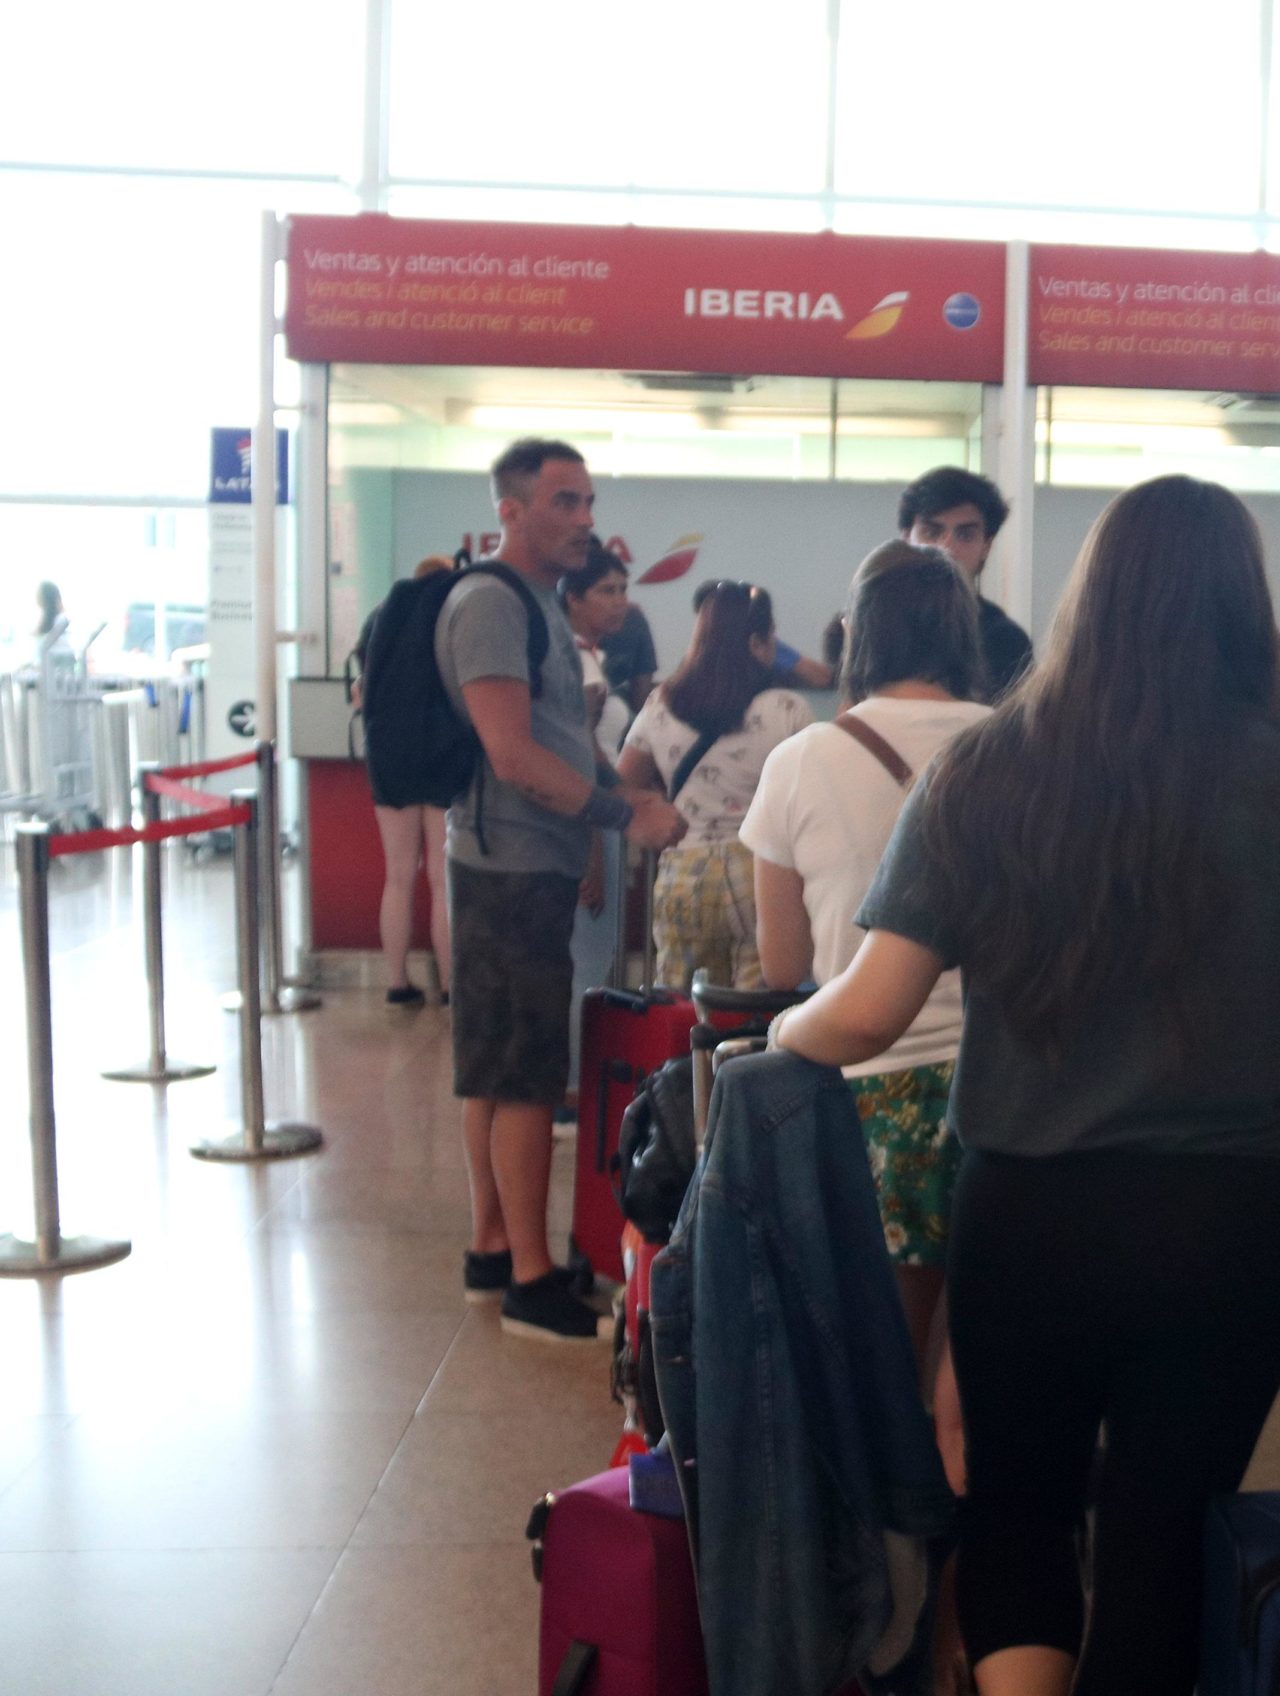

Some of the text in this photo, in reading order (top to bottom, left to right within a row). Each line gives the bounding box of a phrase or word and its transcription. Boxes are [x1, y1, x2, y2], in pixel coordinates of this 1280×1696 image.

[304, 248, 610, 280] Ventas y atención al cliente
[305, 277, 384, 300] Vendes
[398, 280, 480, 304] atenció
[481, 283, 505, 304] al
[506, 283, 567, 306] client
[683, 287, 845, 321] IBERIA
[1038, 277, 1110, 301] Ventas
[1115, 283, 1129, 304] y
[1133, 281, 1226, 305] atención
[1230, 283, 1250, 306] al
[304, 304, 594, 335] Sales and customer service
[1039, 303, 1111, 326] Vendes
[1126, 306, 1203, 329] atenció
[1204, 309, 1225, 330] al
[1038, 329, 1090, 352] Sales
[1094, 332, 1136, 354] and
[1137, 335, 1233, 358] customer
